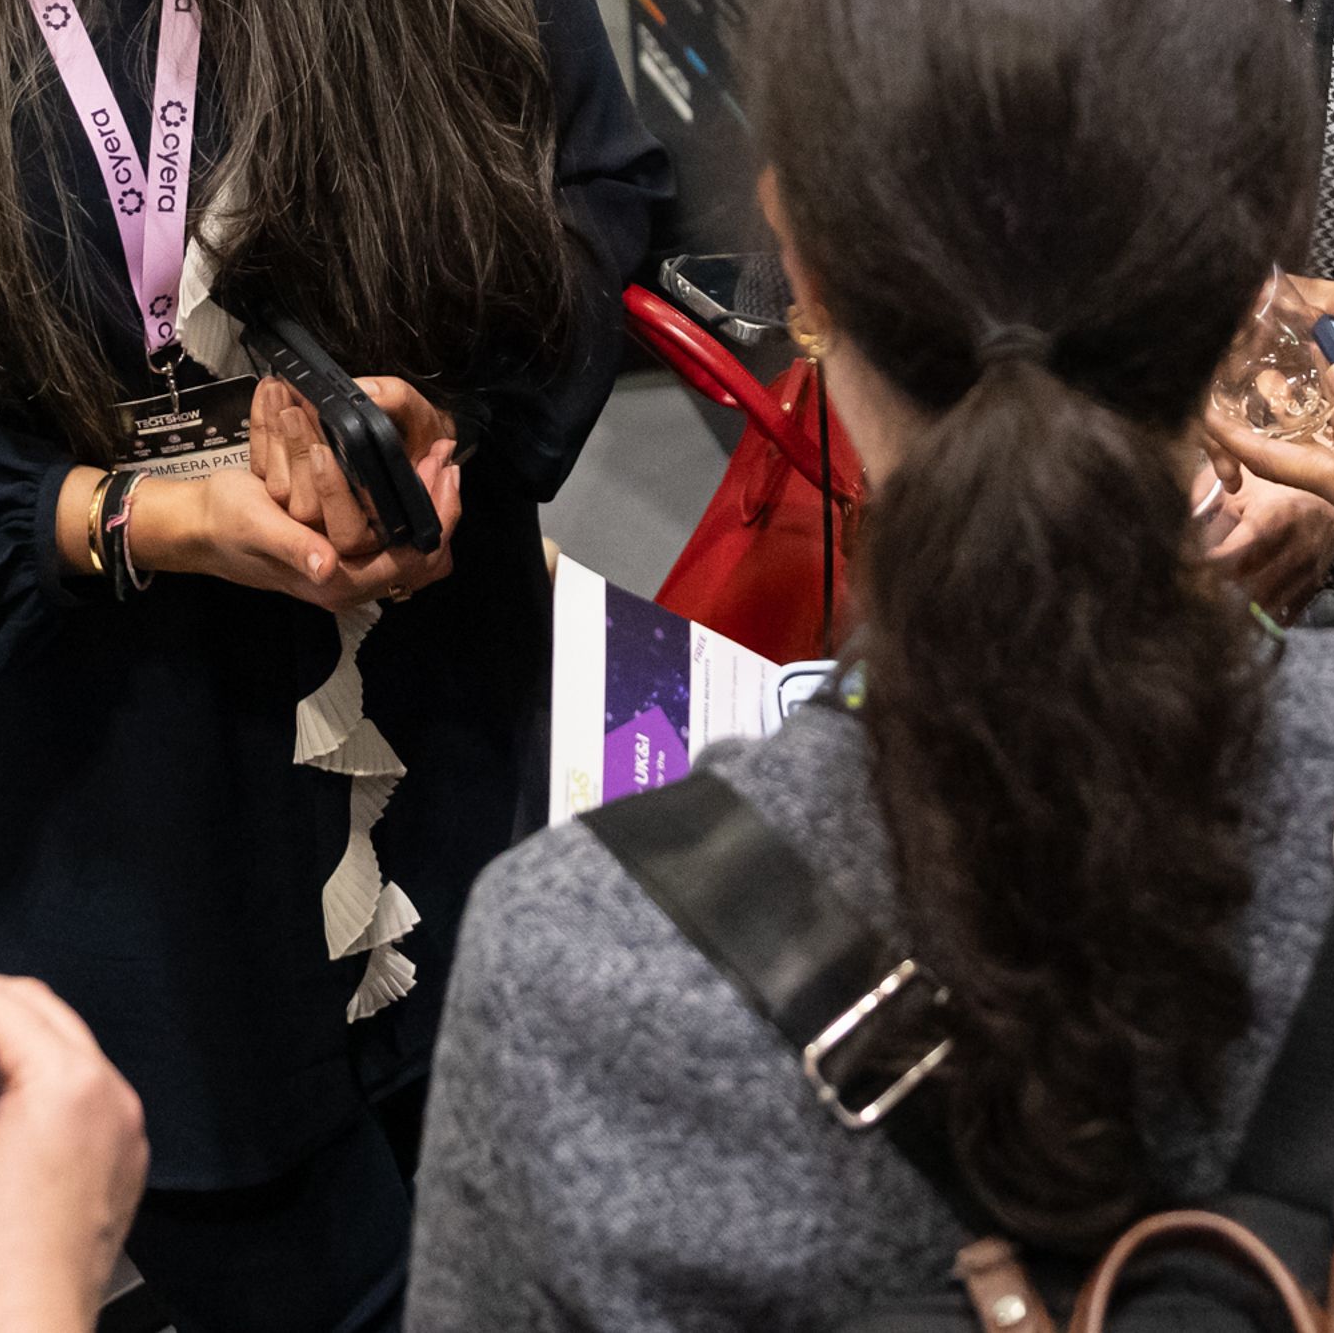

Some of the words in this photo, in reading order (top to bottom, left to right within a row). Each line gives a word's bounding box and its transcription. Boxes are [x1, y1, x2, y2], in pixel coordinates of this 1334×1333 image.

[91, 108, 133, 186] cyera
[157, 133, 181, 214] cyera
[135, 417, 165, 430] TECH
[166, 409, 201, 426] SHOW
[634, 732, 651, 785] UK&I
